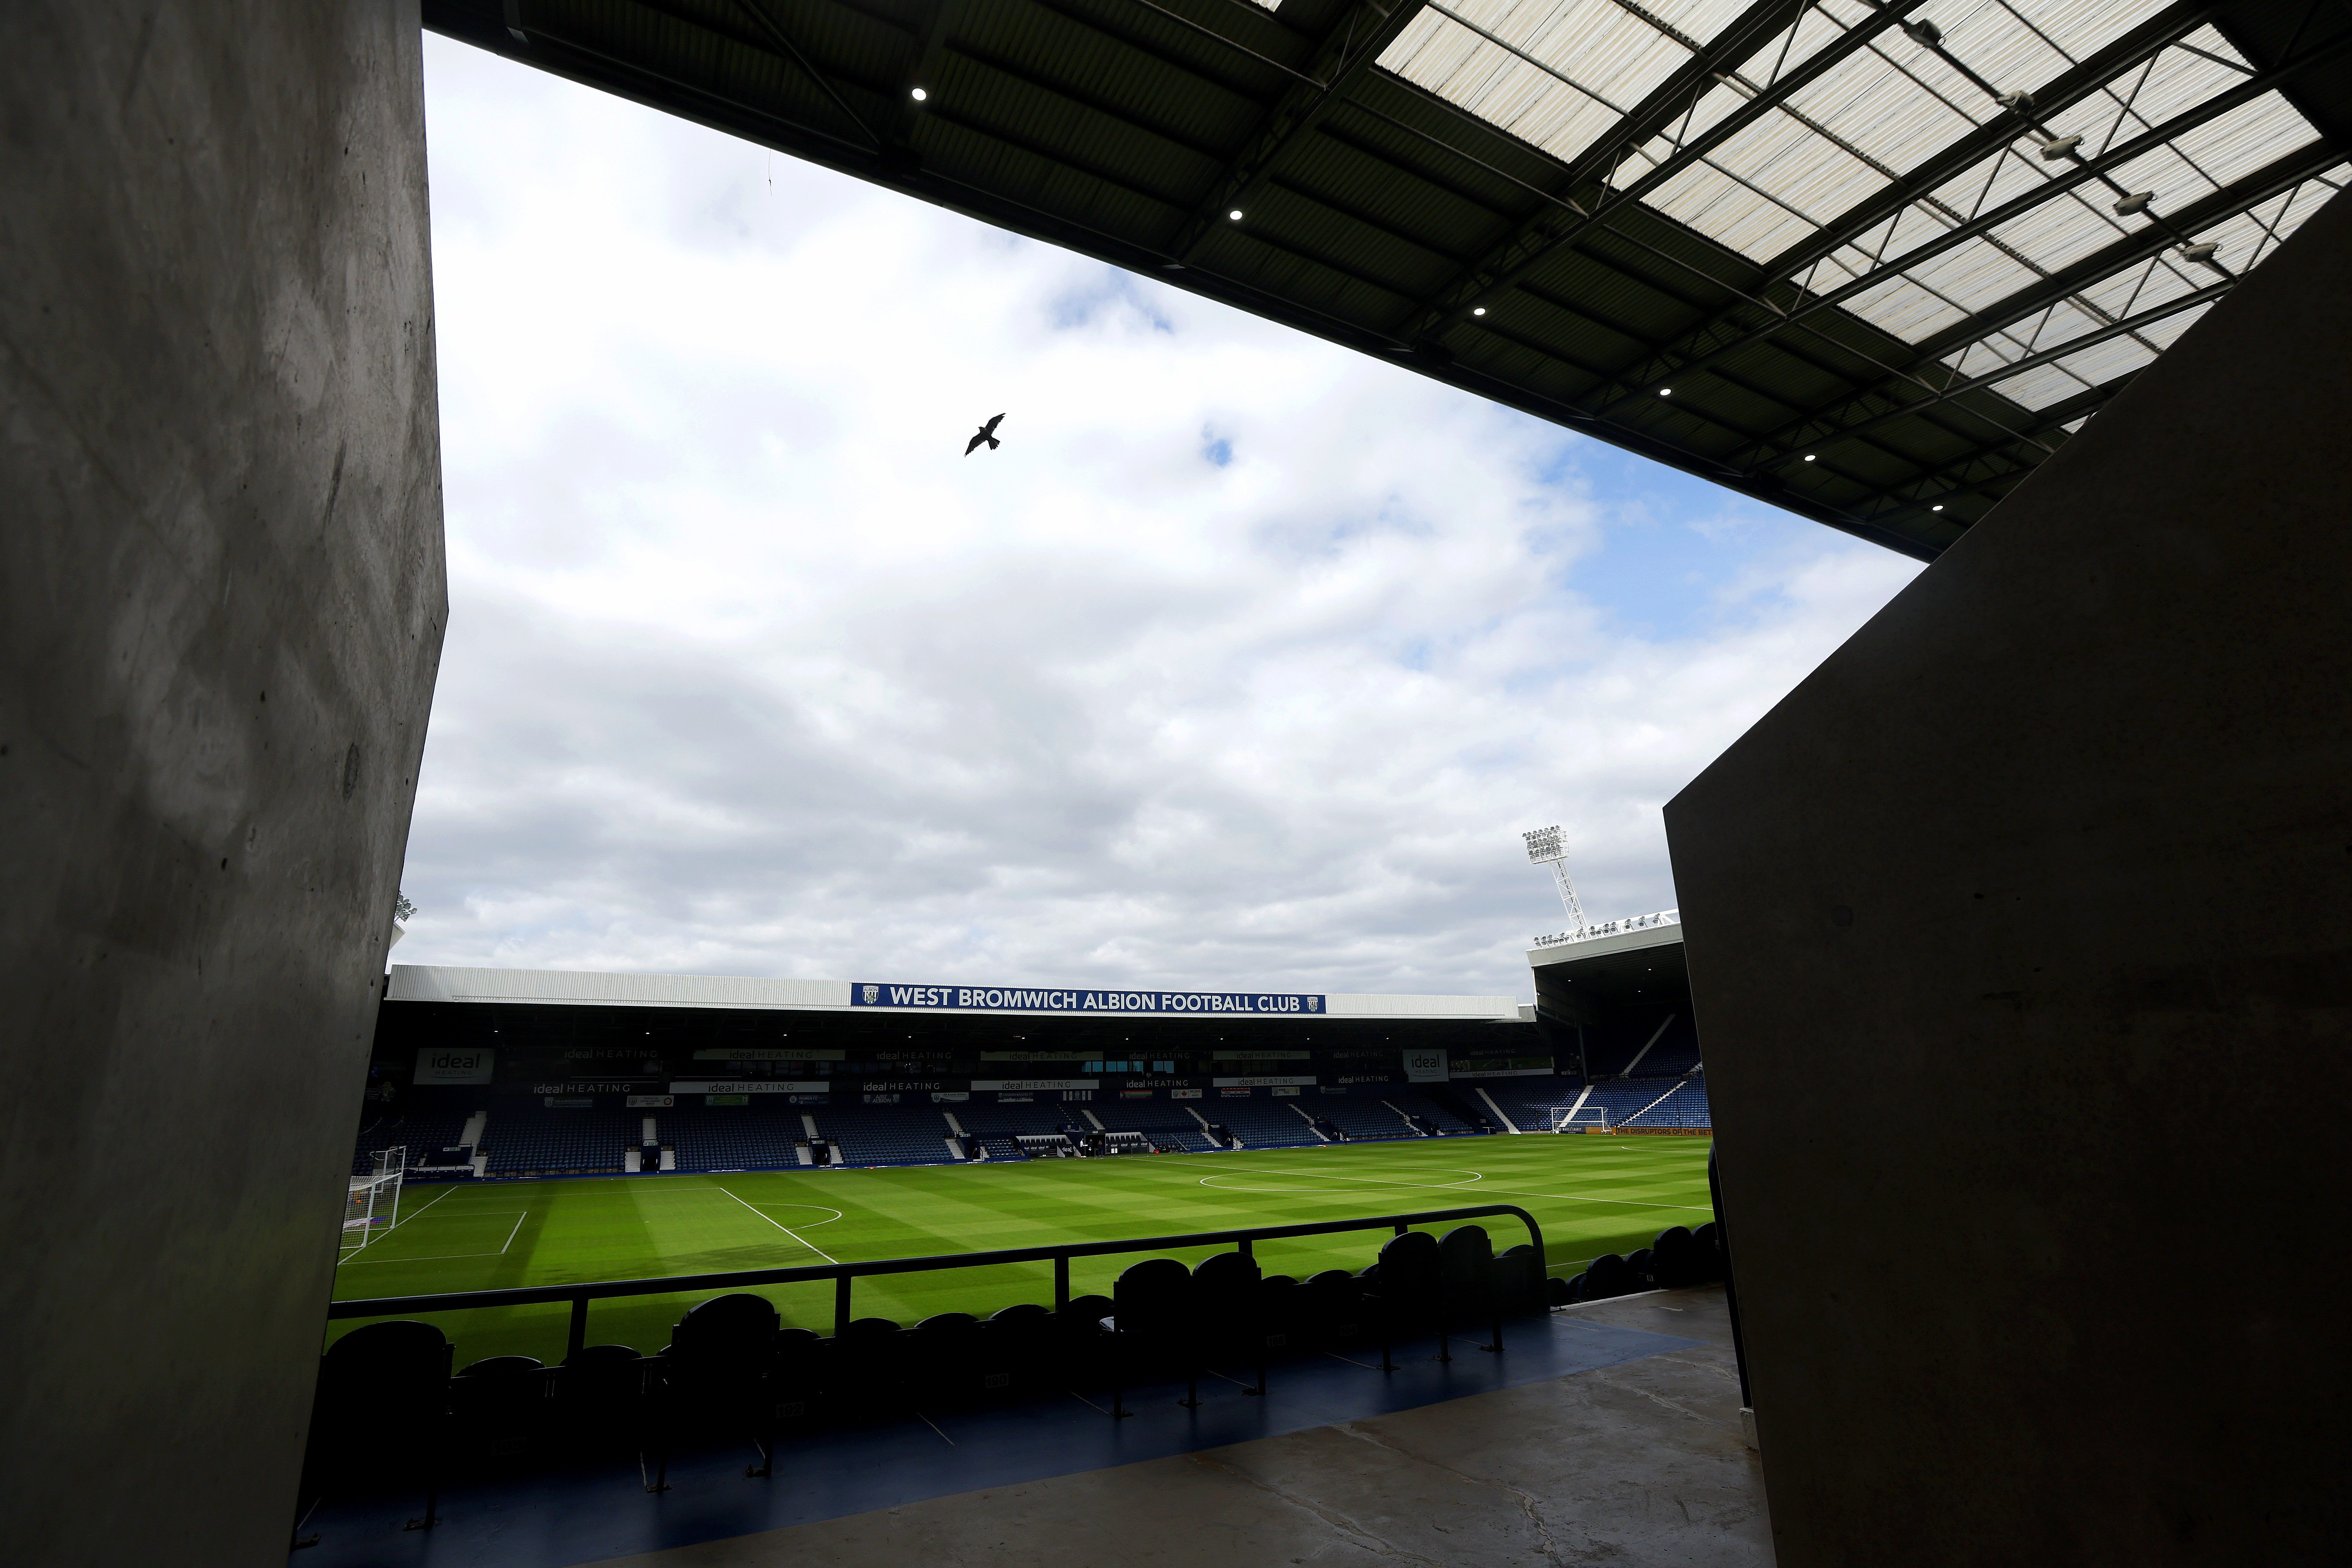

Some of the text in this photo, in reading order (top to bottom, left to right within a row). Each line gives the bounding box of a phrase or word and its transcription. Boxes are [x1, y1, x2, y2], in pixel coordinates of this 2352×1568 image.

[890, 986, 1300, 1012] WEST BROMWICH ALBION FOOTBALL CLUB
[564, 1049, 593, 1058] ideal
[730, 1050, 755, 1059] ideal
[877, 1051, 899, 1060] ideal
[431, 1053, 480, 1068] ideal
[1412, 1054, 1440, 1068] ideal
[534, 1083, 563, 1094] ideal
[708, 1083, 734, 1092] ideal
[864, 1082, 887, 1091] ideal
[1127, 1080, 1145, 1088] ideal
[1341, 1325, 1355, 1336] 184
[1269, 1336, 1284, 1346] 186
[987, 1375, 1007, 1387] 190
[778, 1403, 802, 1417] 192
